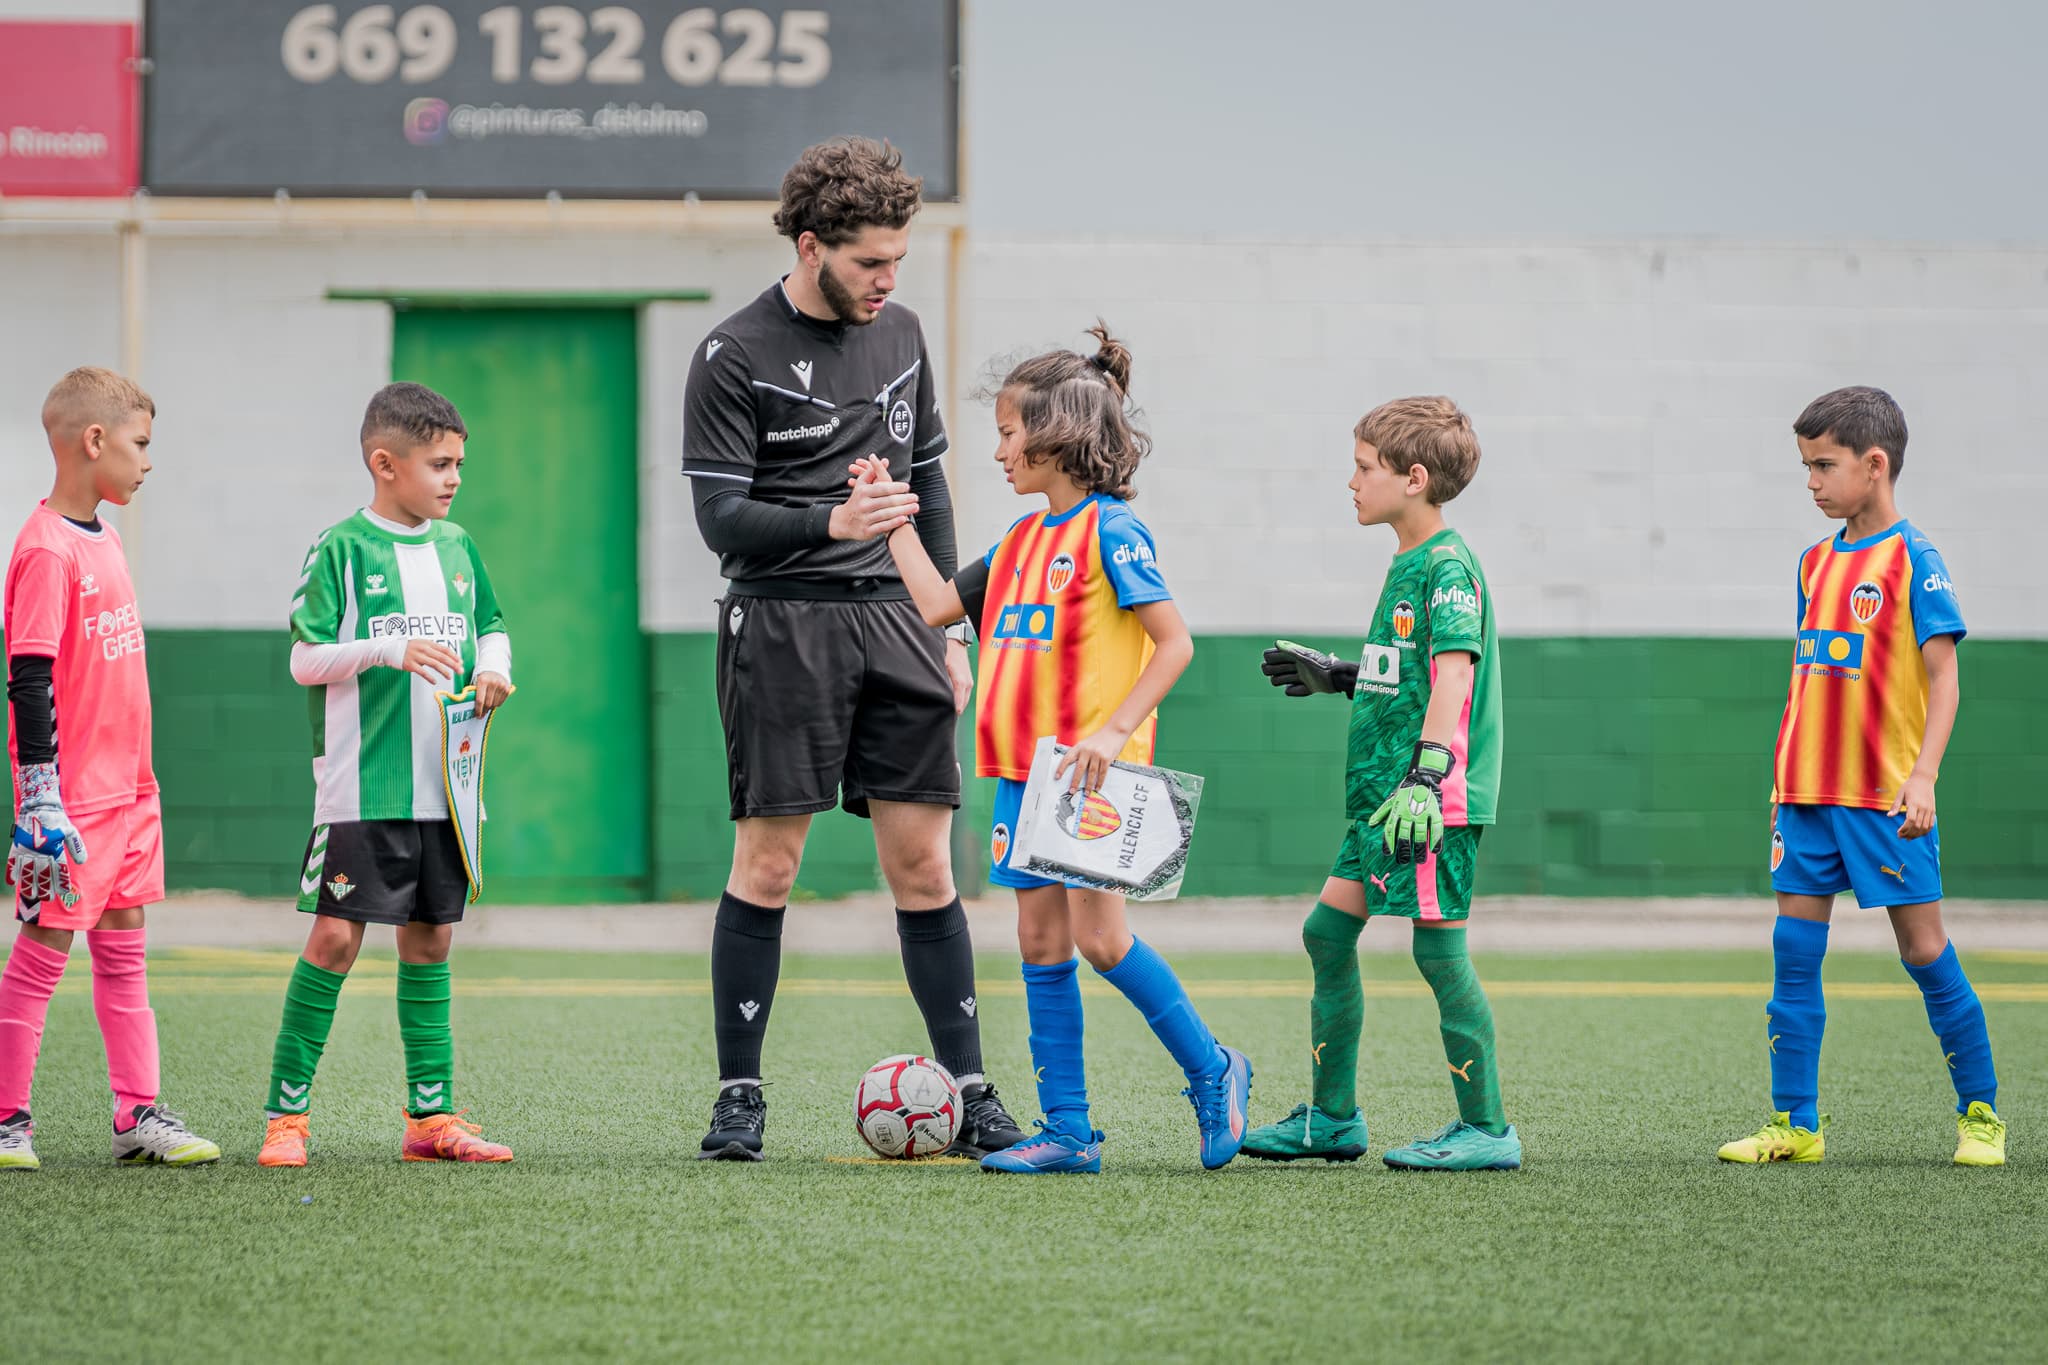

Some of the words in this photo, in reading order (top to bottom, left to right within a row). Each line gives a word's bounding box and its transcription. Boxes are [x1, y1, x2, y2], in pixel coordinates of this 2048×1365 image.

[281, 4, 457, 84] 669
[478, 6, 645, 84] 132
[661, 7, 832, 87] 625
[767, 425, 833, 442] matchapp
[103, 627, 145, 661] GREE
[1800, 638, 1815, 657] TM
[1117, 806, 1145, 869] VALENCIA
[1132, 783, 1150, 802] CF
